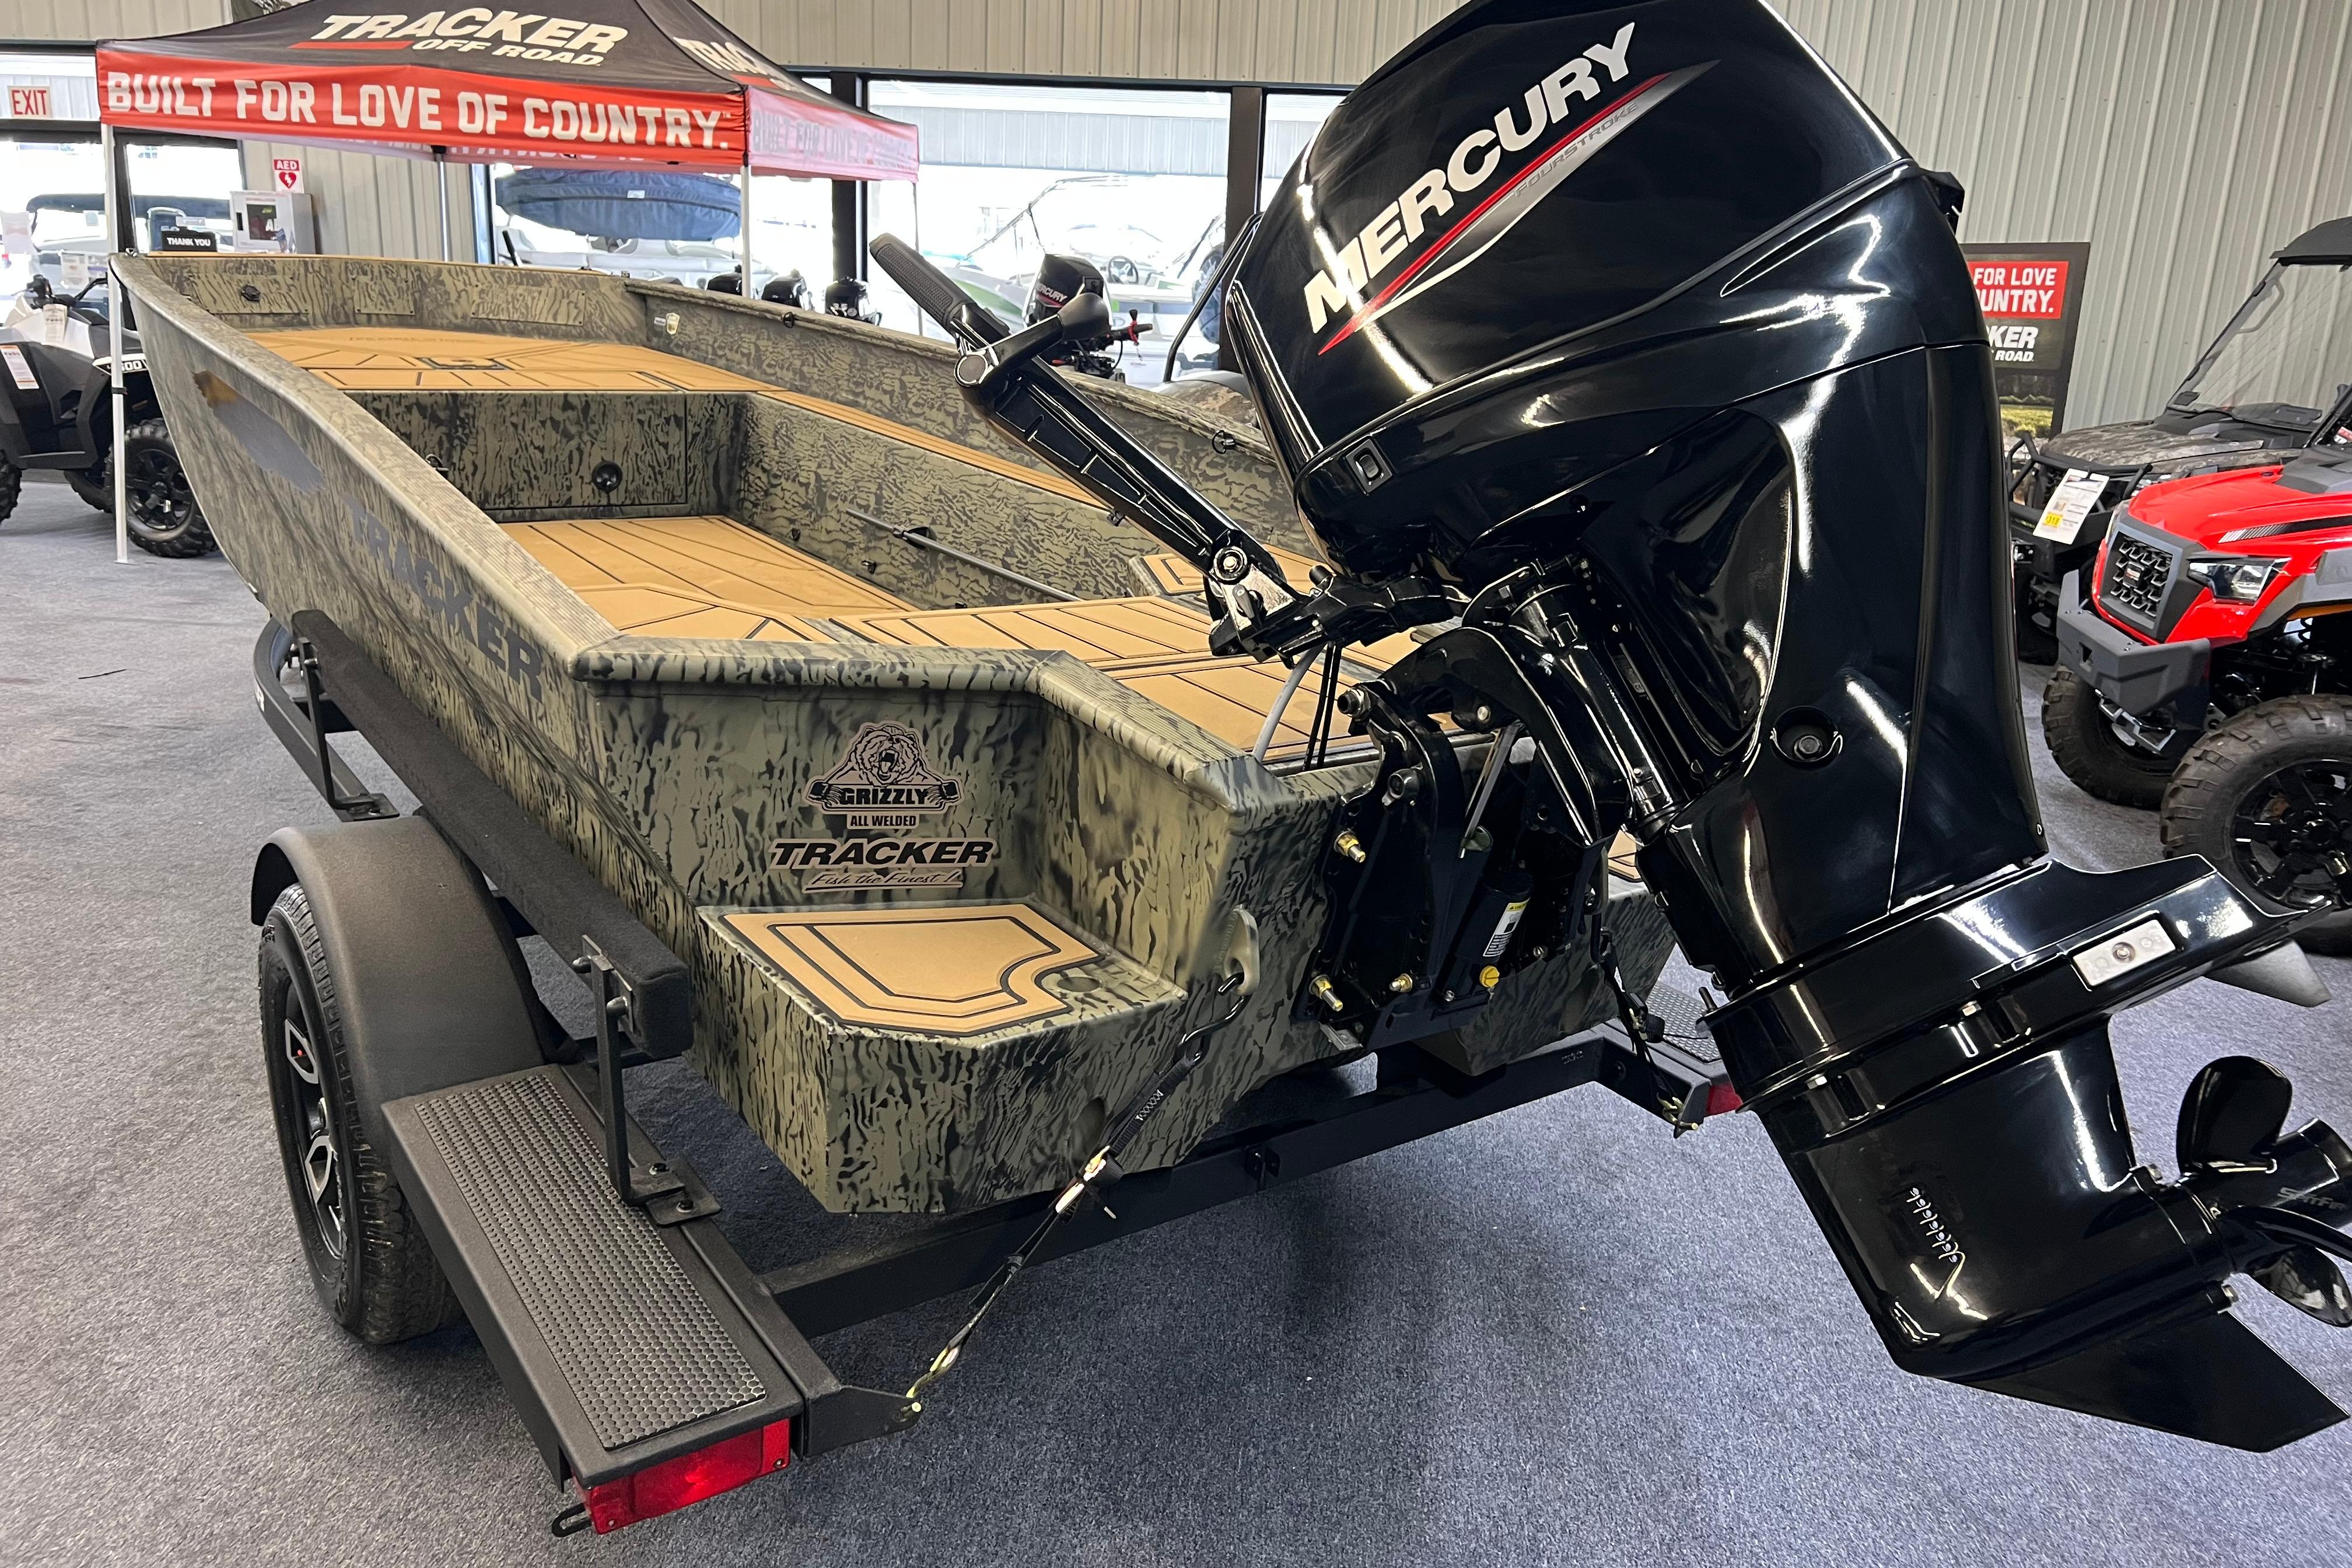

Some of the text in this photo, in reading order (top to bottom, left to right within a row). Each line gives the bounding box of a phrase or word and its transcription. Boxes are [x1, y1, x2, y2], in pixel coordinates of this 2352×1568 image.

[310, 8, 628, 54] TRACKER
[412, 38, 603, 66] OFF ROAD
[12, 90, 47, 115] EXIT
[107, 71, 216, 117] BUILT
[234, 79, 317, 123] FOR
[331, 83, 442, 131] LOVE
[457, 91, 508, 134] OF
[1514, 101, 1639, 197] FOURSTROKE
[276, 160, 297, 170] AED
[1304, 22, 1634, 333] MERCURY
[167, 237, 194, 246] THANK
[1973, 268, 2057, 286] FOR LOVE
[1986, 325, 2039, 349] KER
[1994, 349, 2035, 362] ROAD
[343, 496, 544, 705] TRACKER
[839, 788, 928, 805] GRIZZLY
[850, 815, 916, 827] ALL WELDED
[775, 841, 994, 866] TRACKER
[811, 873, 851, 885] Fish
[854, 873, 881, 884] the
[884, 872, 939, 884] Finest
